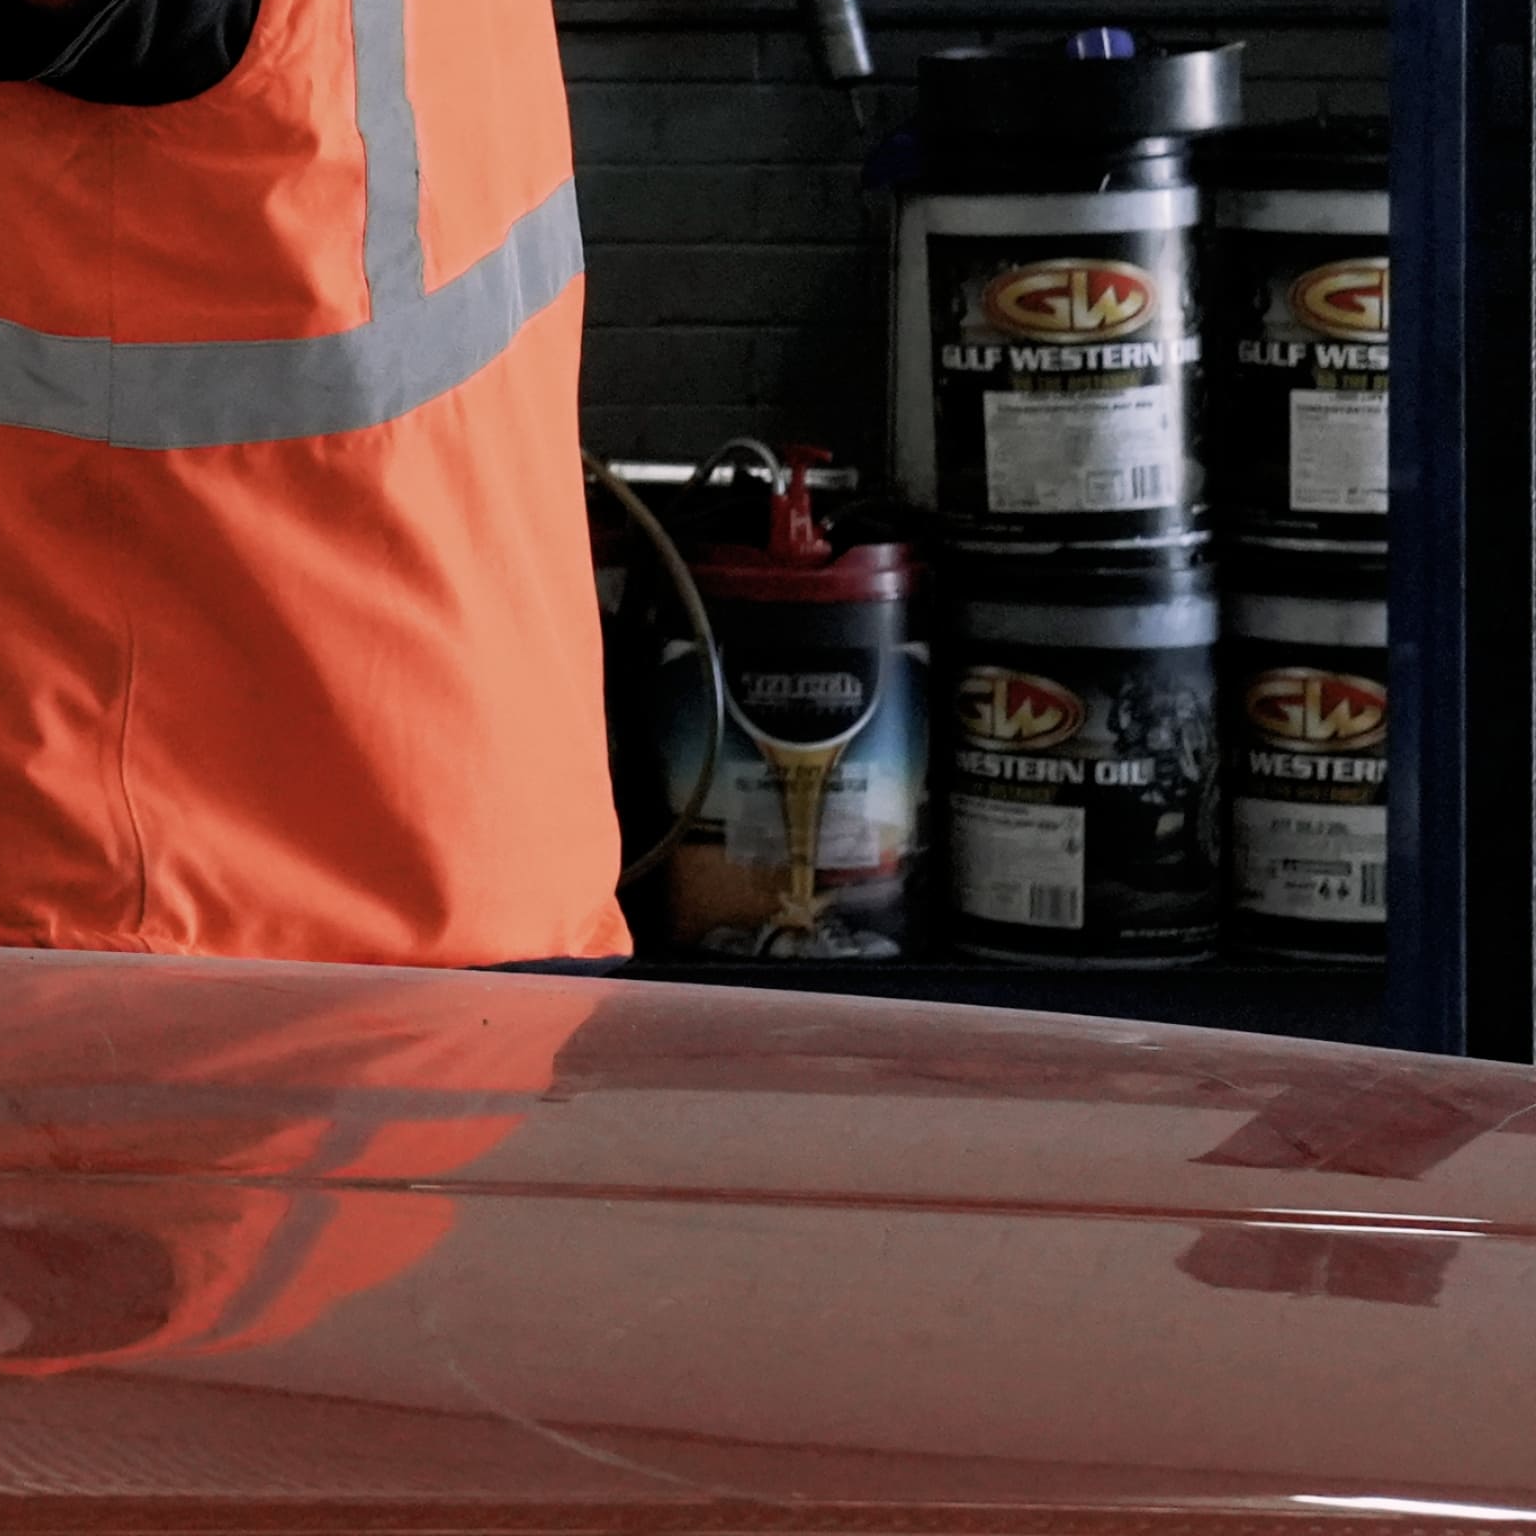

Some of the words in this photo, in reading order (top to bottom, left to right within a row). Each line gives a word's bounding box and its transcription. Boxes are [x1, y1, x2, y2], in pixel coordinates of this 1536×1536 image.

[997, 271, 1144, 331] GW
[1302, 273, 1388, 331] G
[942, 345, 1003, 370] GULF
[1009, 341, 1164, 371] WESTERN
[1239, 340, 1307, 368] GULF
[1315, 343, 1389, 371] WES
[1253, 678, 1383, 739] GW
[1094, 756, 1154, 785] OIL
